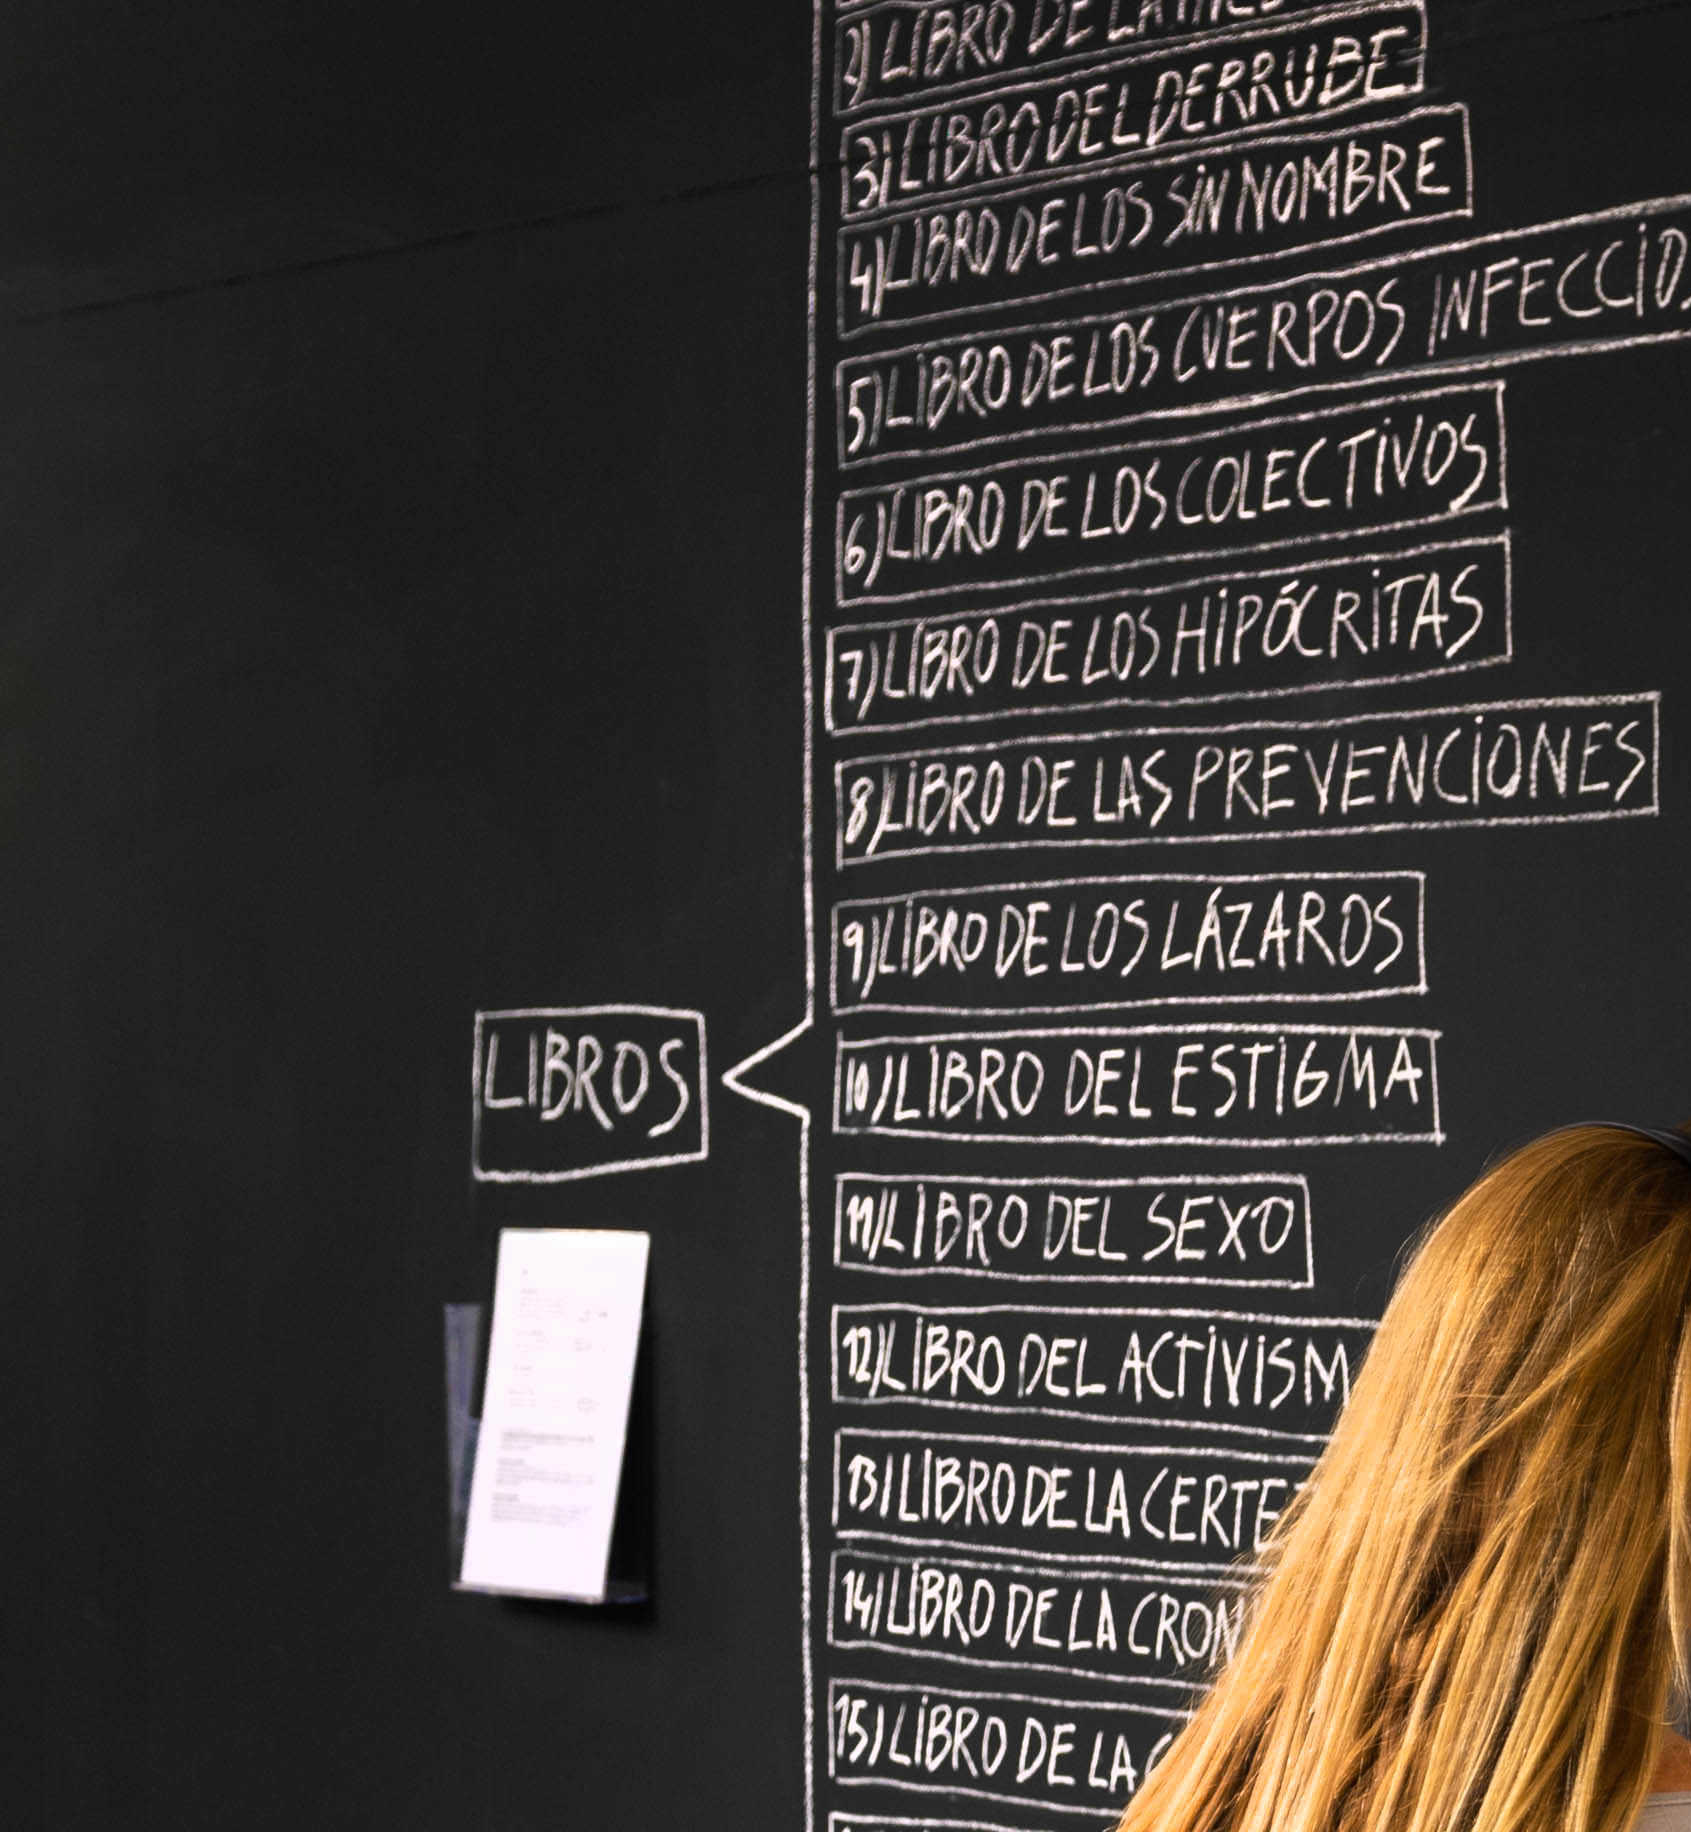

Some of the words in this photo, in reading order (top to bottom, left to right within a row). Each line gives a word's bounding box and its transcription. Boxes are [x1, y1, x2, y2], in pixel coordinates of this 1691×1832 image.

[1146, 26, 1407, 147] DERRUBE
[1234, 136, 1450, 234] NOMBRE
[1174, 277, 1405, 383] CUERPOS
[1177, 411, 1489, 526] COLECTIVOS
[1018, 755, 1077, 826] DE
[1093, 747, 1170, 827] LAS
[1190, 715, 1646, 821] PREVENCIONES
[1162, 886, 1404, 976] LÁZAROS
[486, 1027, 690, 1138] LIBROS
[1065, 1047, 1151, 1118] DEL
[1172, 1033, 1423, 1120] ESTIGMA
[1044, 1190, 1128, 1262] DEL
[1144, 1195, 1295, 1263] SEXO
